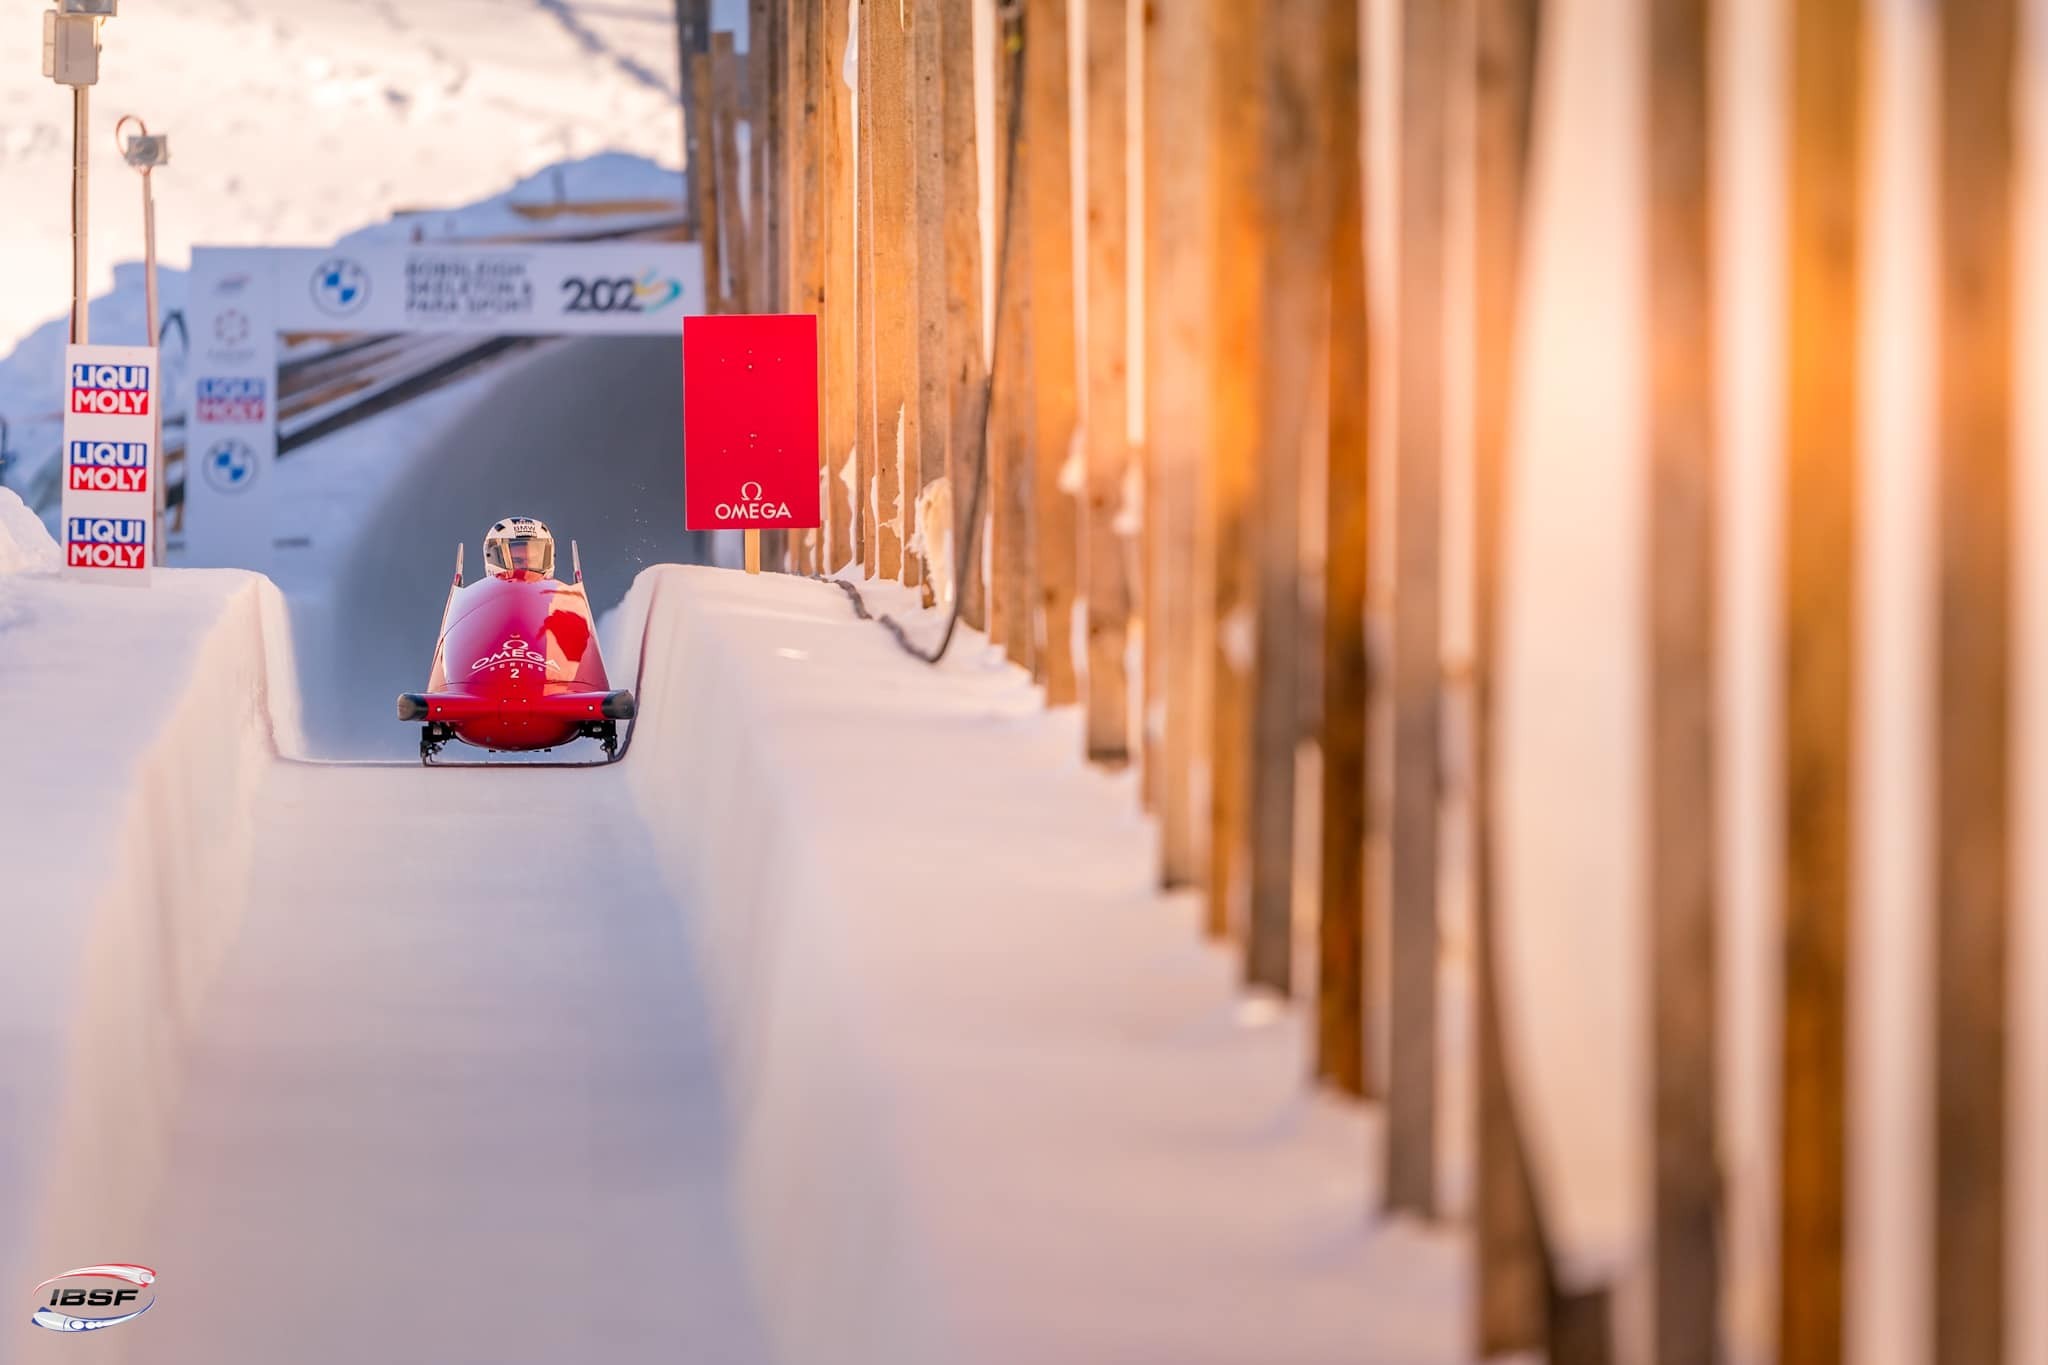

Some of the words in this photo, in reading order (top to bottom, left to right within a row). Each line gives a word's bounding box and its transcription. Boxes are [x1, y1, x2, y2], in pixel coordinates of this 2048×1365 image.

[75, 366, 147, 390] LIQUI
[75, 390, 148, 414] MOLY
[73, 443, 145, 467] LIQUI
[73, 467, 146, 491] MOLY
[715, 502, 792, 520] OMEGA
[71, 519, 144, 543] LIQUI
[70, 544, 144, 568] MOLY
[471, 648, 561, 672] OMEGA
[510, 669, 520, 679] 2
